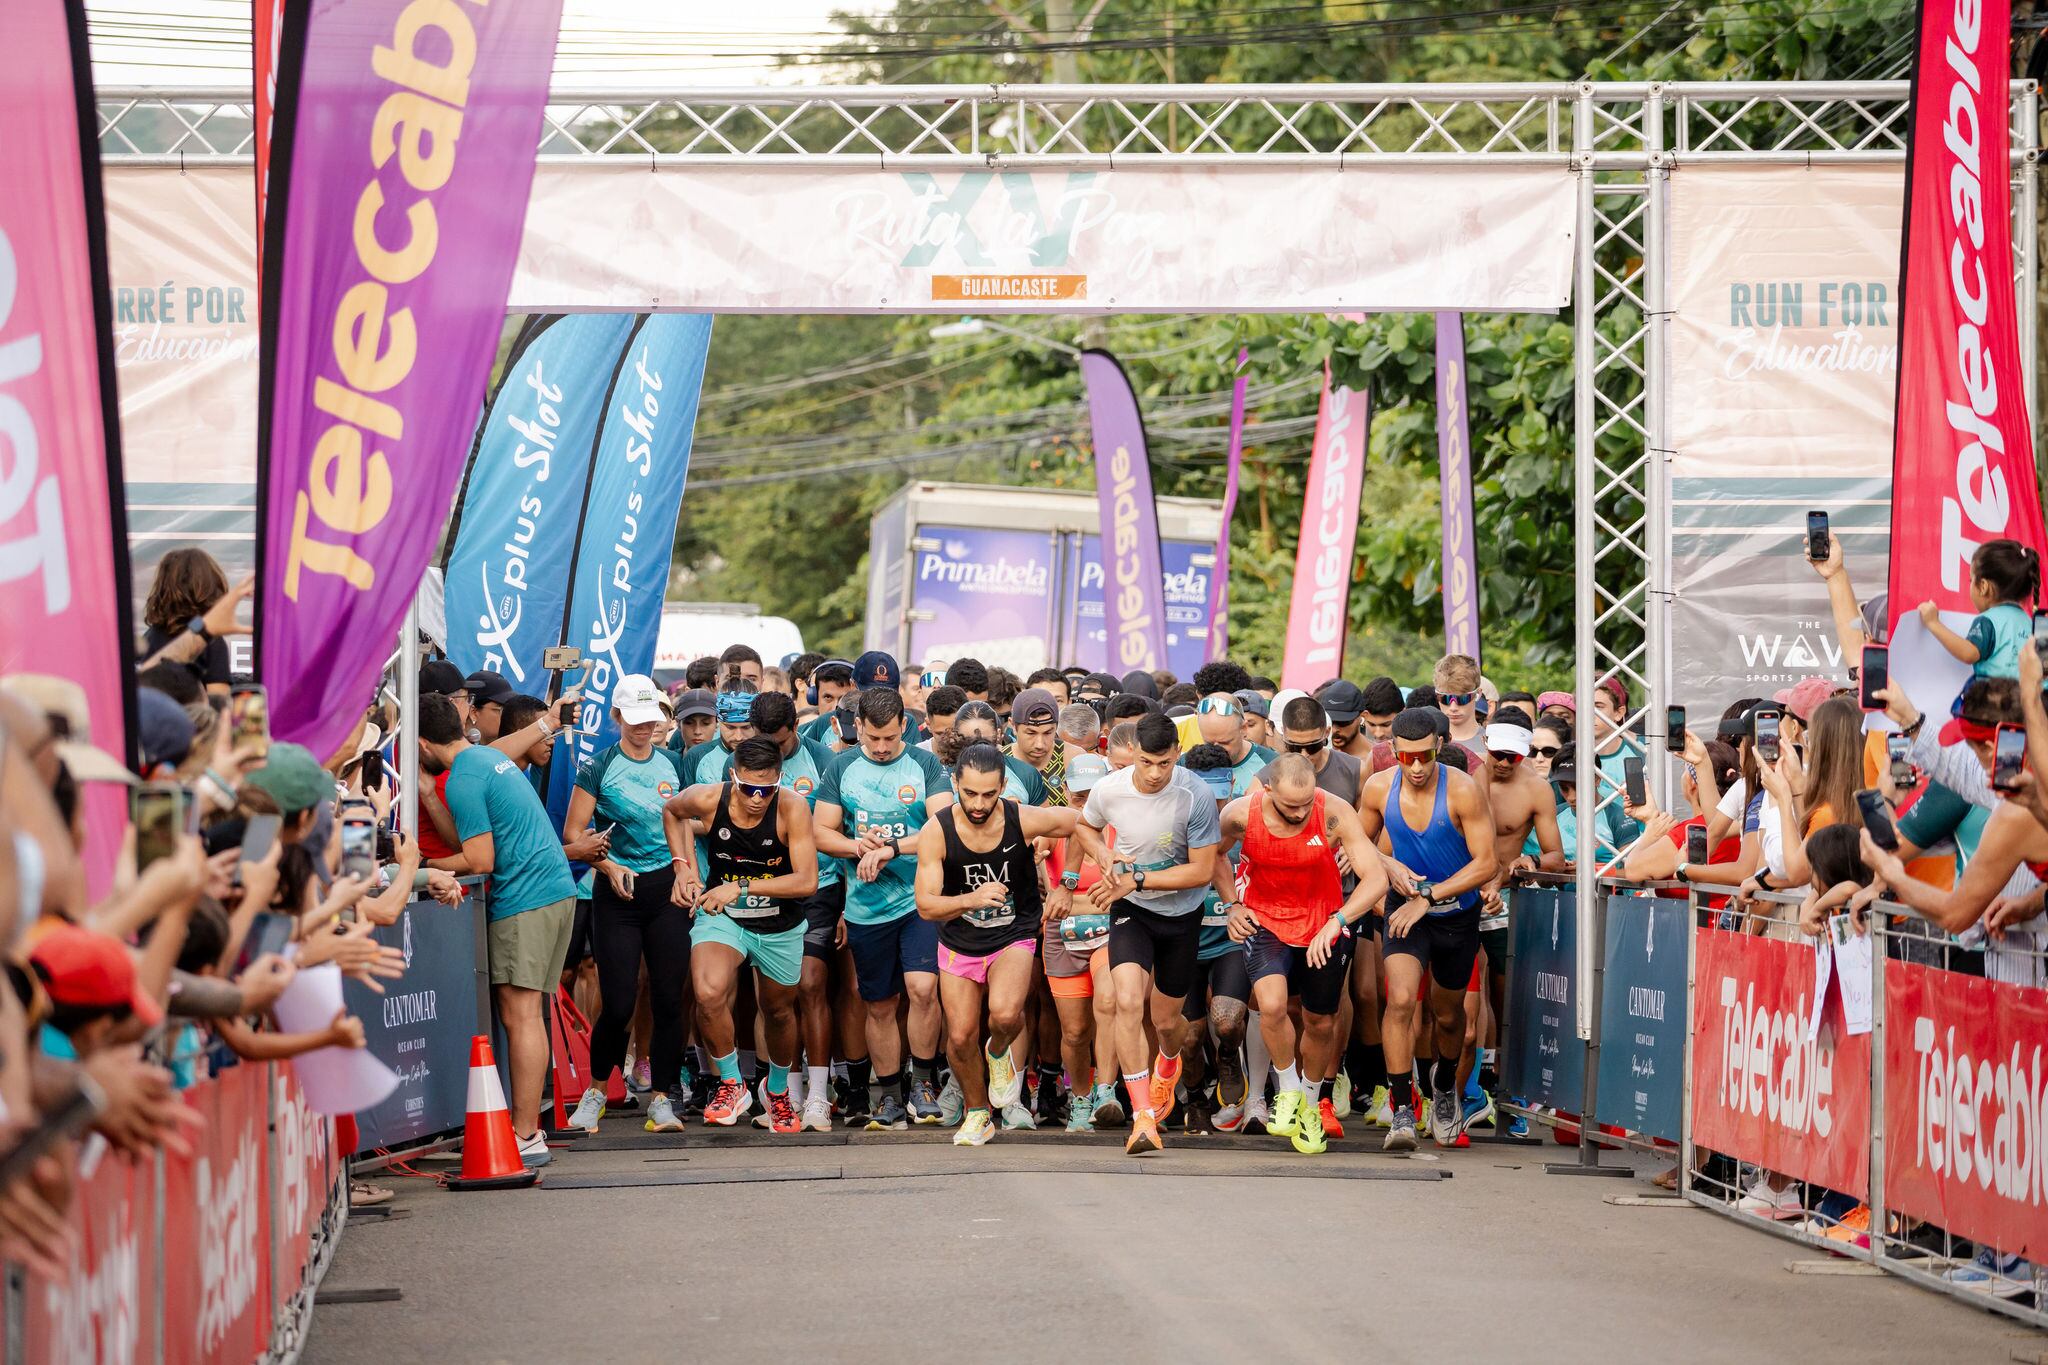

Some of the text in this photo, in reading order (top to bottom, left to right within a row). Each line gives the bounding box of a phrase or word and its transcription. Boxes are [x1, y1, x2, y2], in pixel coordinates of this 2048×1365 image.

[112, 281, 246, 324] RRÉ POR
[285, 0, 490, 603] Telecab
[961, 278, 1058, 297] GUANACASTE
[1731, 283, 1889, 327] RUN FOR
[1716, 320, 1898, 379] Education
[623, 347, 663, 478] Shot
[504, 360, 563, 590] plus Shot
[613, 495, 642, 594] plus
[920, 553, 1048, 590] Primabela
[1797, 621, 1821, 629] THE
[1737, 634, 1843, 668] WAV
[1746, 674, 1793, 682] SPORTS
[1536, 971, 1569, 1006] CANTOMAR
[1628, 986, 1666, 1023] CANTOMAR
[383, 990, 438, 1029] CANTOMAR
[398, 1037, 426, 1054] OCEAN CLUB
[1720, 976, 1835, 1138] Telecable
[1914, 1016, 2048, 1207] Telecabl
